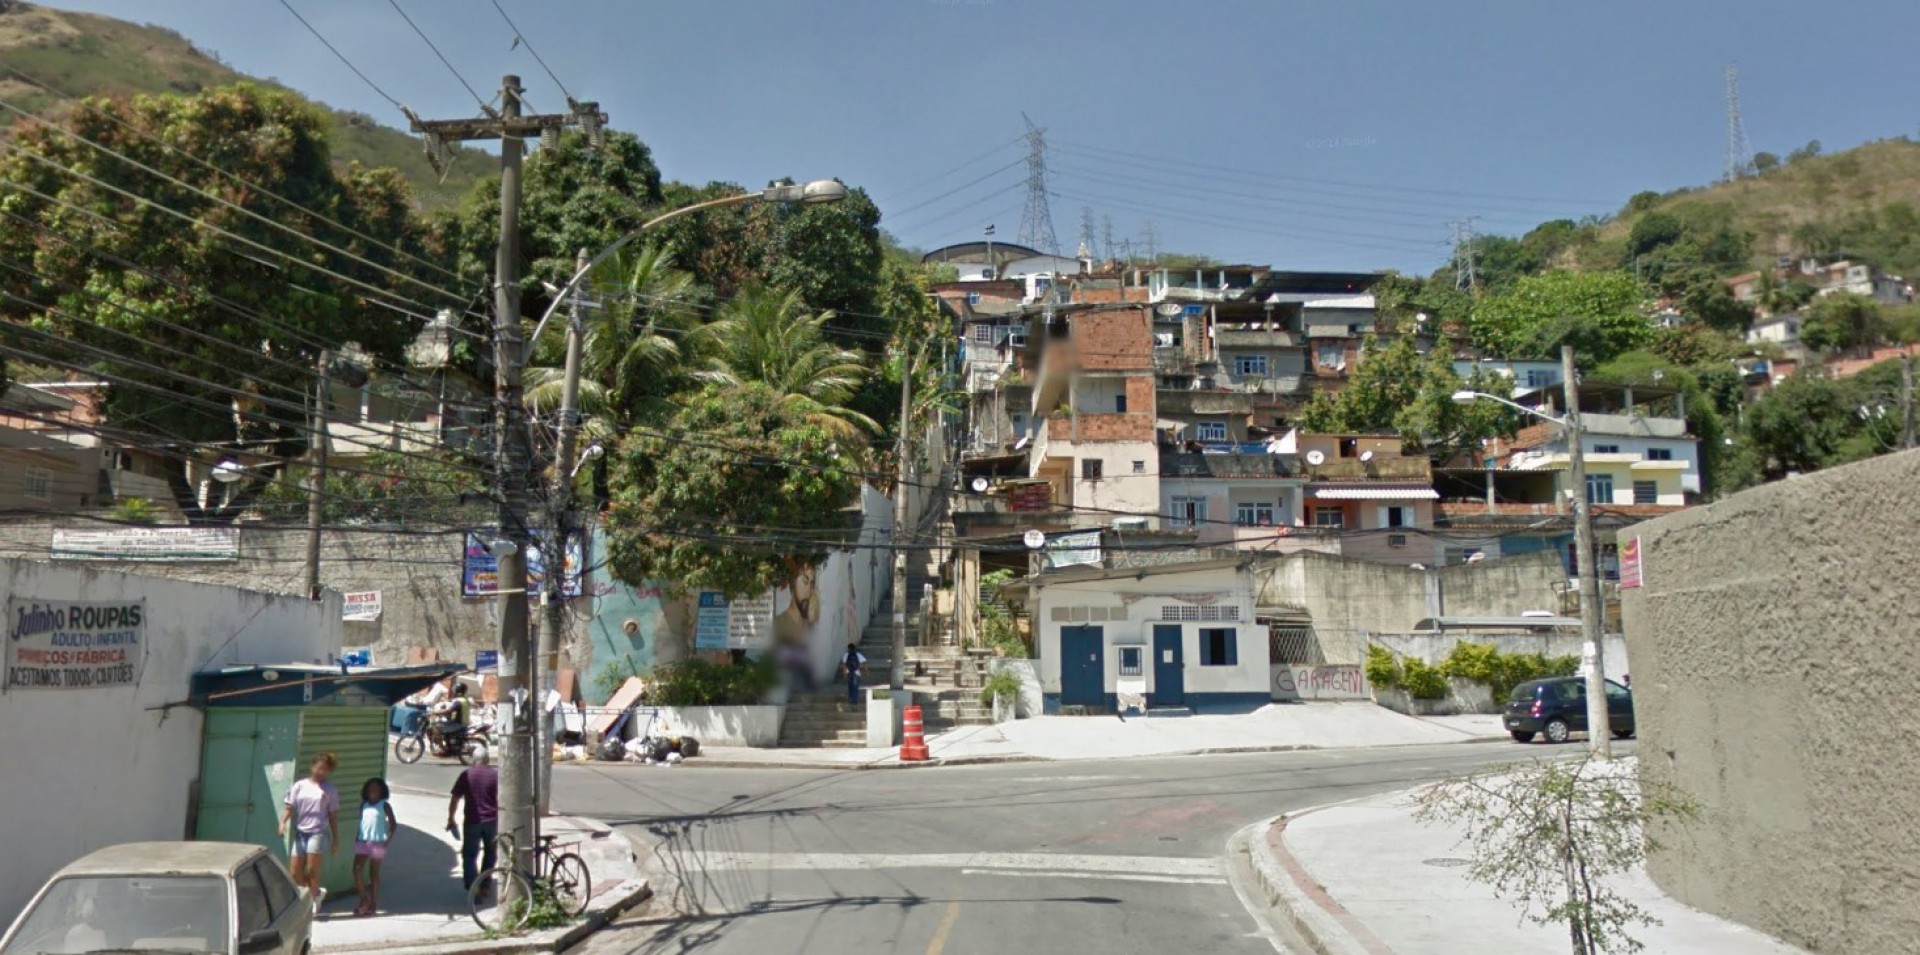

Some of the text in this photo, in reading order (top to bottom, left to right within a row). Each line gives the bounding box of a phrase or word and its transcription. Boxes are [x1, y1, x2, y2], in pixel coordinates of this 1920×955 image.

[348, 593, 376, 603] MISSA
[11, 604, 141, 641] Julinho ROUPAS
[51, 632, 91, 646] ADULTO
[97, 631, 138, 646] INFANTIL
[75, 647, 126, 664] FÁBRICA
[8, 666, 61, 686] ACEITAMOS
[63, 667, 90, 686] TODOS
[95, 662, 134, 683] CARTÕES
[1275, 668, 1363, 693] GARAGEM
